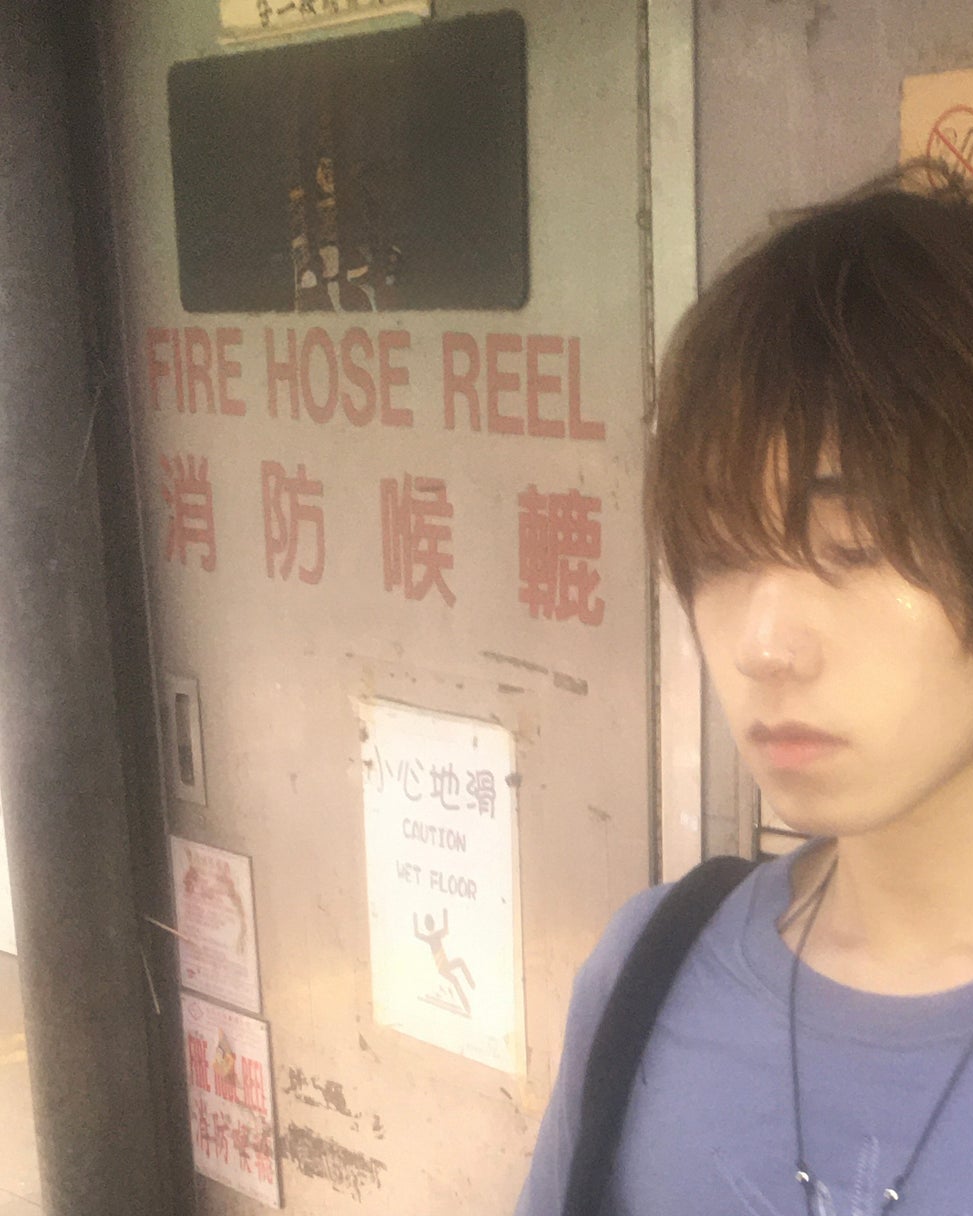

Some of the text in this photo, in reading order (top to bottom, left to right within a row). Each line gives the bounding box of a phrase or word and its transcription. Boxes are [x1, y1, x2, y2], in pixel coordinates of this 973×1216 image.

[146, 326, 606, 441] FIRE HOSE REEL
[402, 817, 467, 852] CAUTION
[430, 869, 477, 900] FLOOR
